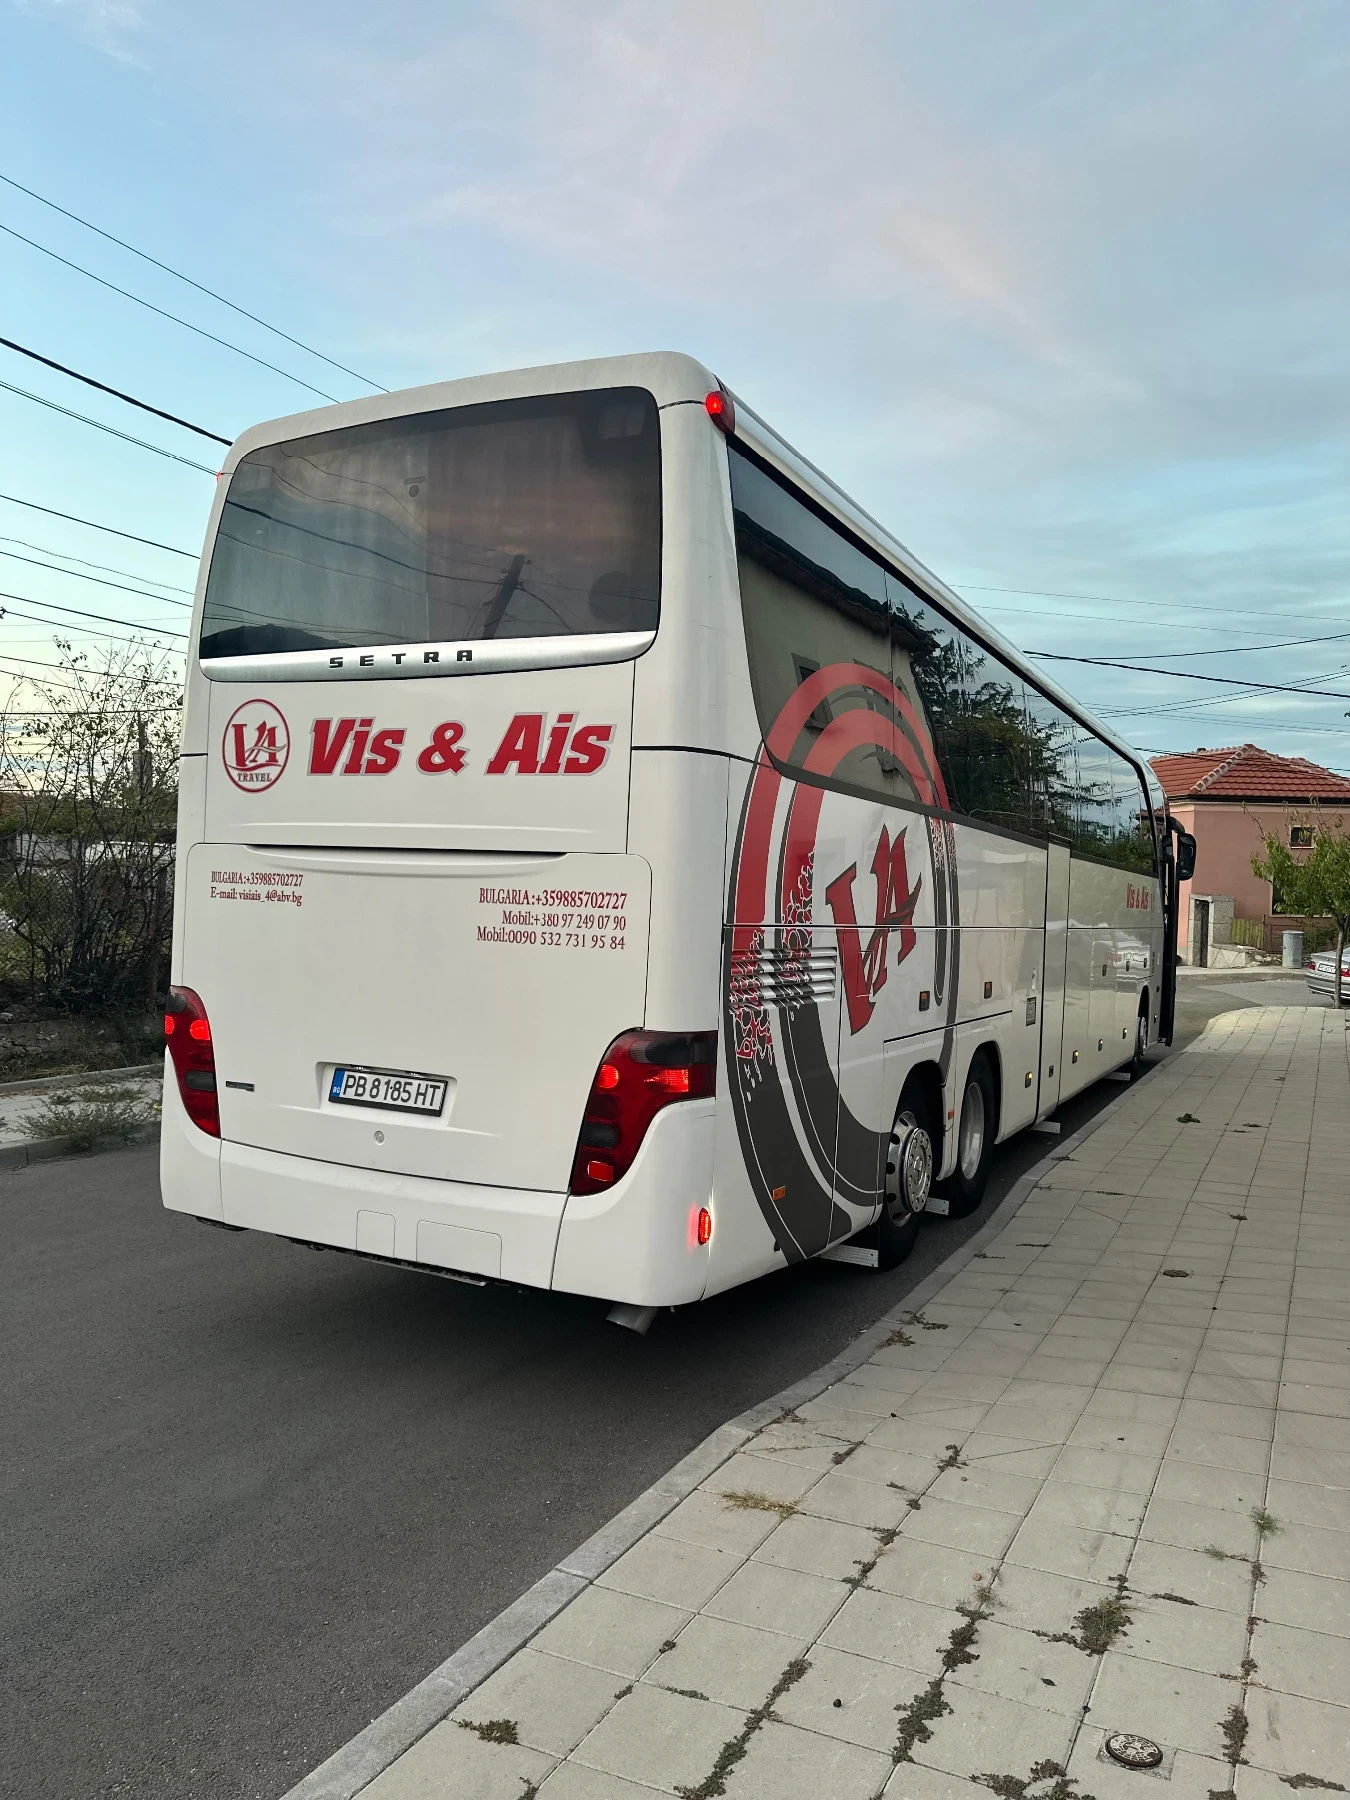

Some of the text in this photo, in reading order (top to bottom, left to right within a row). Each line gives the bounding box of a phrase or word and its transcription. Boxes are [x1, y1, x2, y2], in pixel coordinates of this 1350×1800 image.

[328, 649, 473, 669] SETRA
[307, 711, 618, 777] Vis & Ais
[237, 772, 272, 782] TRAVEL
[210, 886, 303, 907] E-mail: visiais_4@abv.bg
[501, 910, 627, 932] Mobil:+380 97 249 07 90
[476, 925, 626, 950] Mobil:0090 532 731 95 84
[343, 1074, 441, 1107] PB 8185 HT
